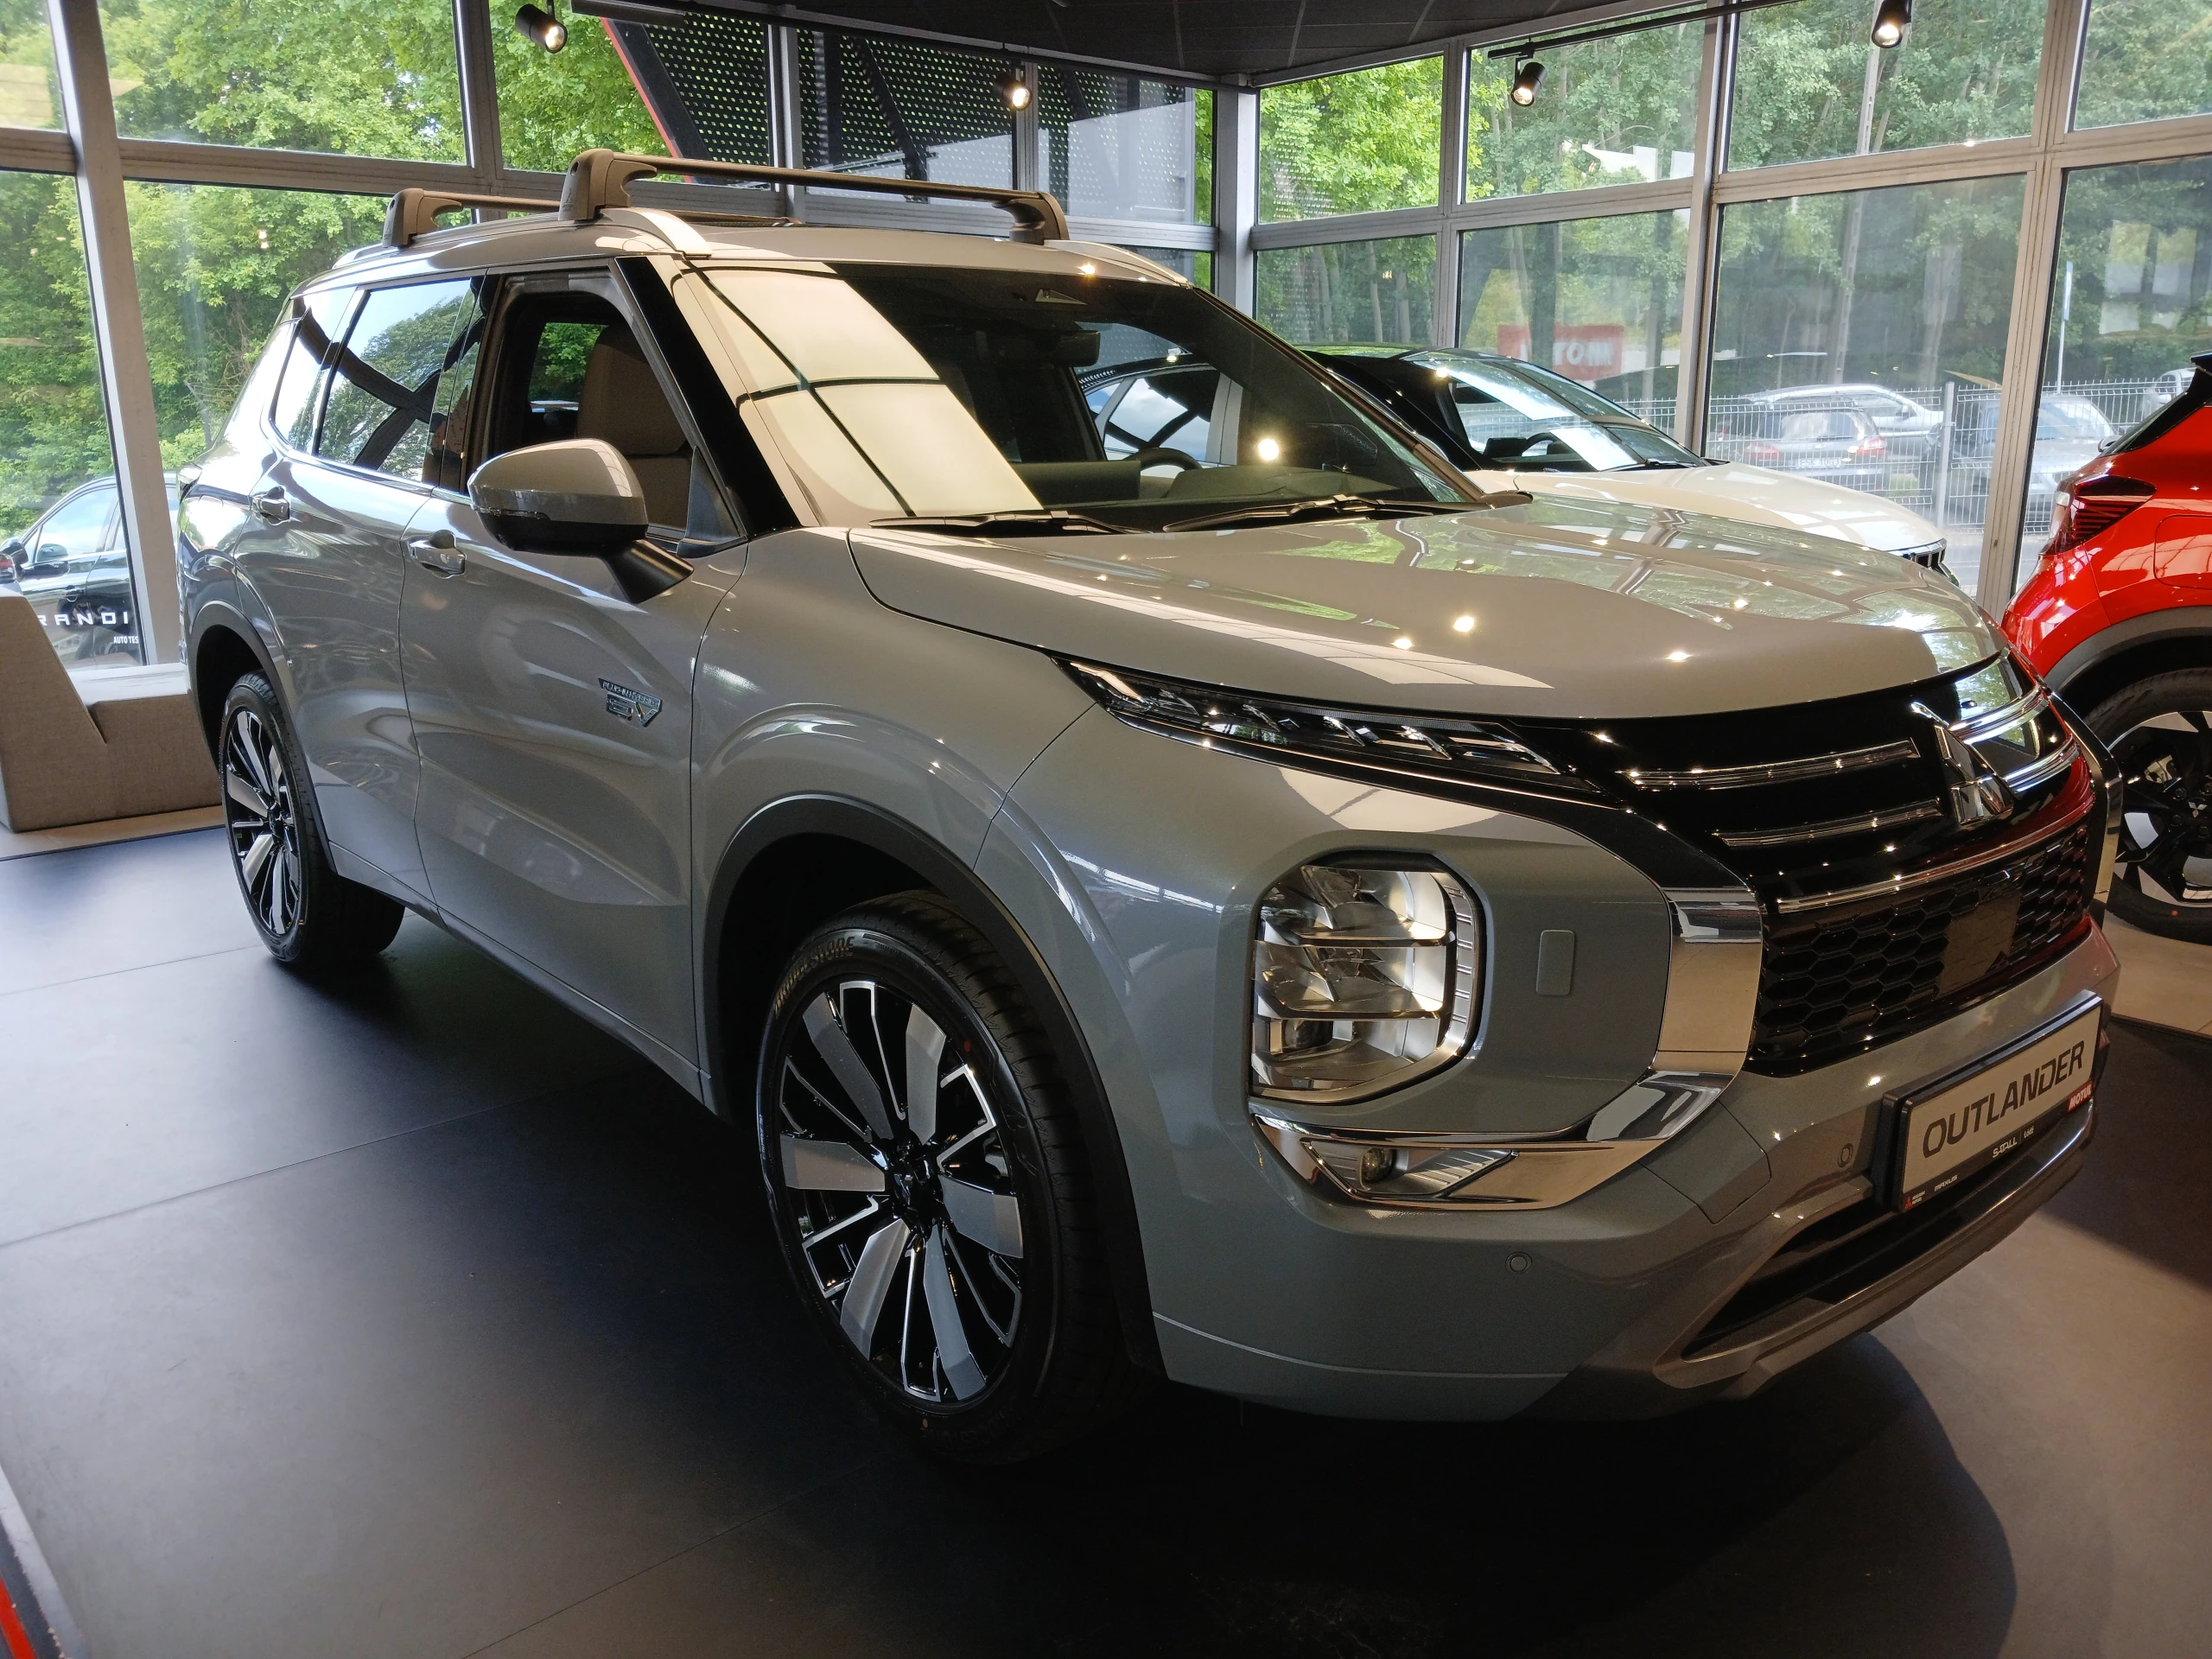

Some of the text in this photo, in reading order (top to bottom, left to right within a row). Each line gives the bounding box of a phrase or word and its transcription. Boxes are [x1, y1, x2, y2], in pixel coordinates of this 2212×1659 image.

[1922, 1039, 2085, 1159] OUTLANDER
[2069, 1084, 2092, 1110] MOTUL
[1934, 1174, 1958, 1192] MAXUS
